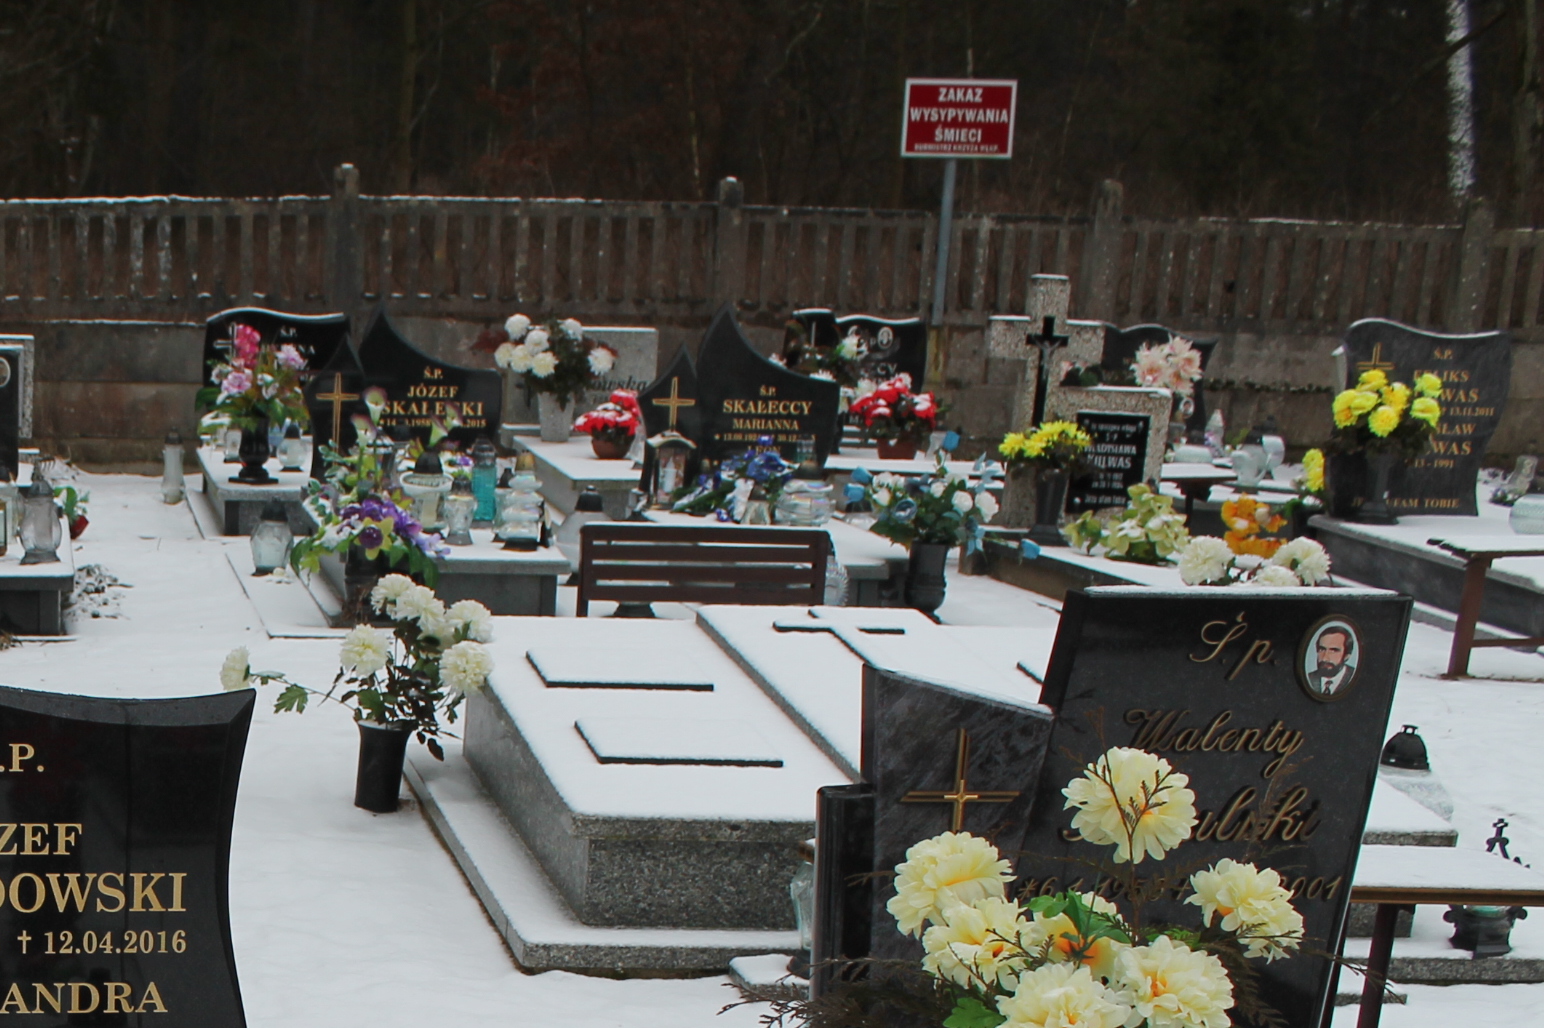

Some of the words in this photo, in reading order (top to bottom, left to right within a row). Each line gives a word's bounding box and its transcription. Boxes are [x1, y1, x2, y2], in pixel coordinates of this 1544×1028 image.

[938, 87, 983, 103] ZAKAZ
[909, 107, 1008, 123] WYSYPYWANIA
[934, 124, 982, 142] ŚMIECI
[407, 383, 459, 398] JÓZEF
[723, 399, 815, 416] SKAŁECCY
[733, 418, 800, 431] MARIANNA
[1123, 706, 1306, 780] Walenty
[44, 930, 187, 955] 12.04.2016
